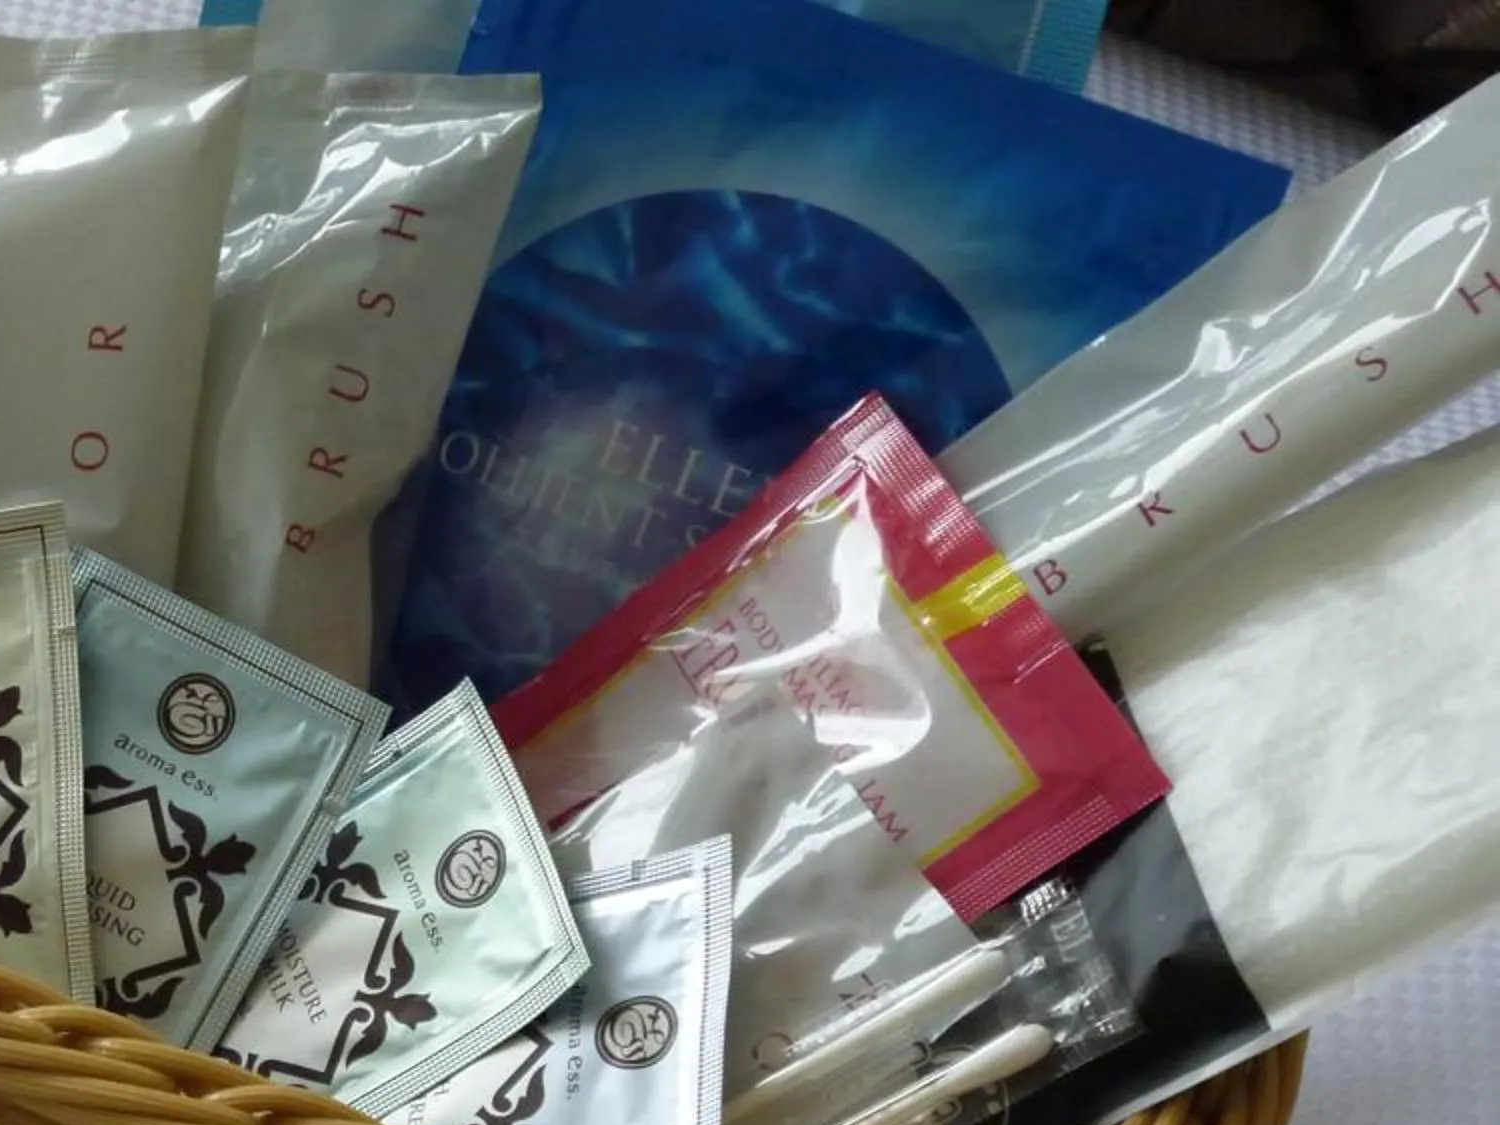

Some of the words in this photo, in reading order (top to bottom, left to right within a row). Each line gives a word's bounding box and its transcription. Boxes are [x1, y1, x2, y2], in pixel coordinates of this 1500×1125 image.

[284, 203, 426, 555] BRUSH
[600, 420, 758, 519] ELLE
[113, 732, 178, 777] aroma
[393, 849, 426, 910] aroma
